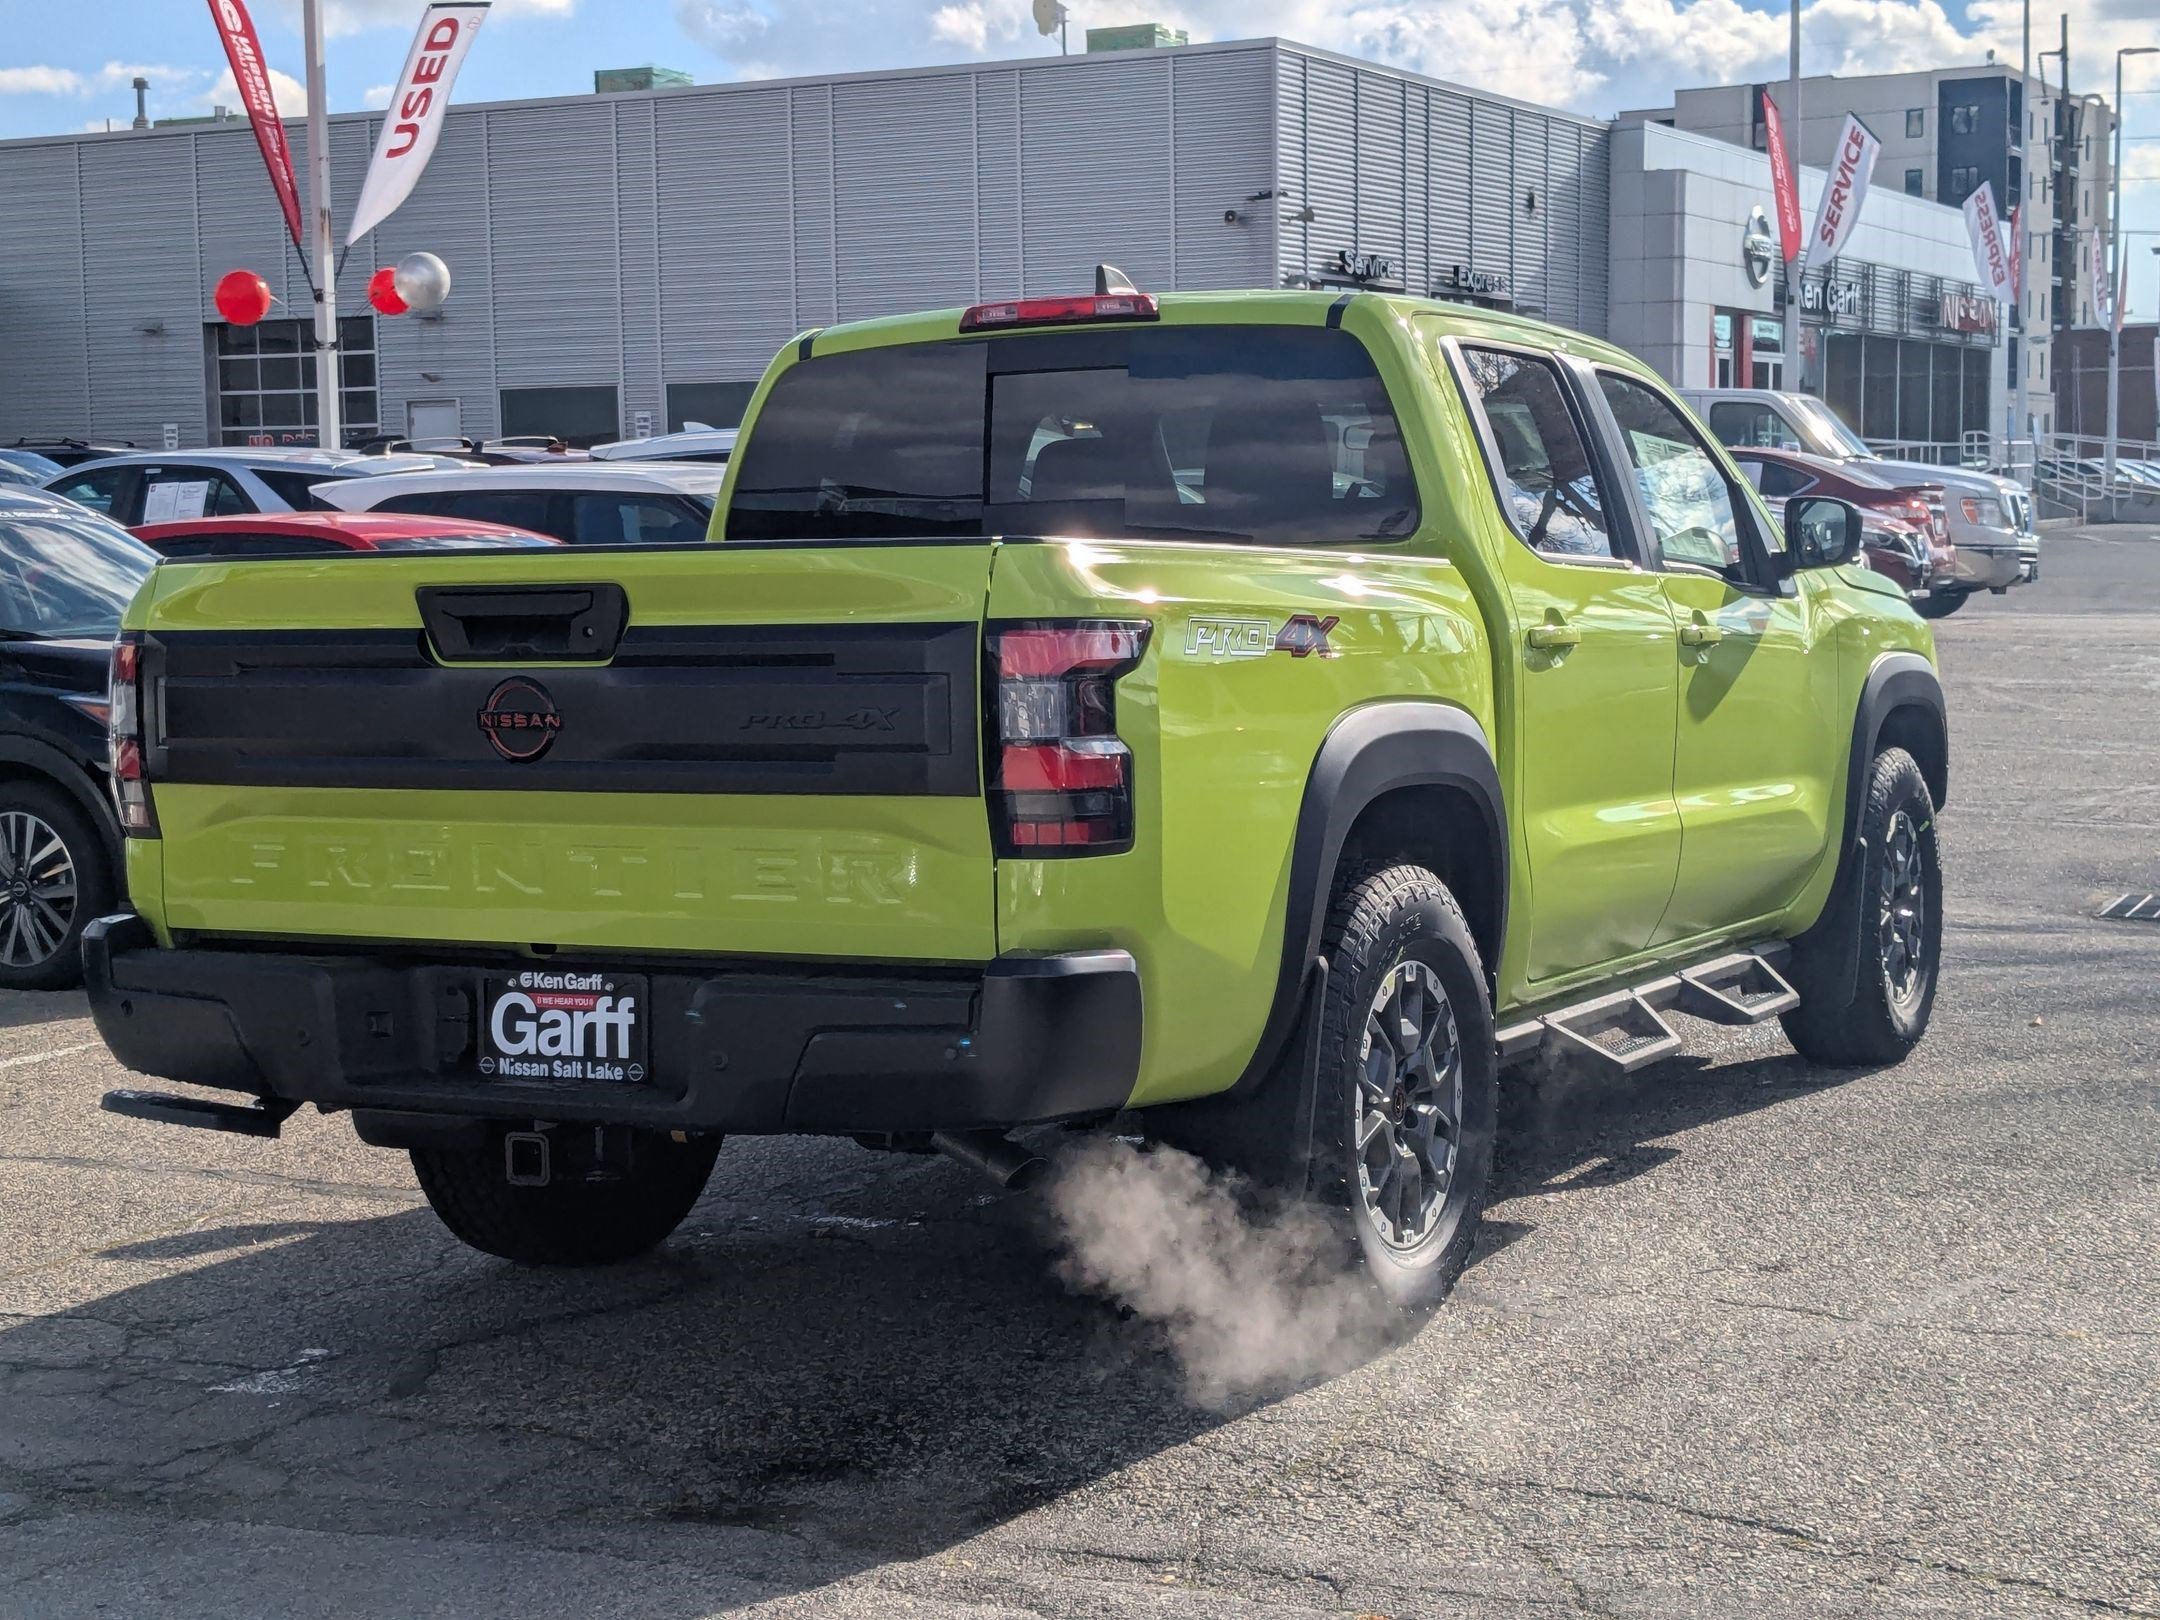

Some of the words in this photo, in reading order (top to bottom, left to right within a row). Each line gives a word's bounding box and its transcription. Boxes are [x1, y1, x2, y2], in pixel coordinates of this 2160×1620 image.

[386, 17, 460, 159] USED
[1821, 126, 1865, 247] SERVICE
[1343, 250, 1396, 278] Service
[1458, 267, 1509, 292] Express
[1826, 279, 1860, 314] Garff
[1184, 614, 1340, 659] PRO-4X
[480, 712, 560, 728] NISSAN
[228, 834, 906, 904] FRONTIER
[533, 972, 563, 989] Ken
[564, 973, 602, 991] Garff
[554, 997, 574, 1005] HEAR
[574, 998, 589, 1006] YOU
[491, 992, 635, 1059] Garff
[499, 1058, 549, 1077] Nissan
[553, 1060, 583, 1078] Salt
[587, 1062, 624, 1081] Lake
